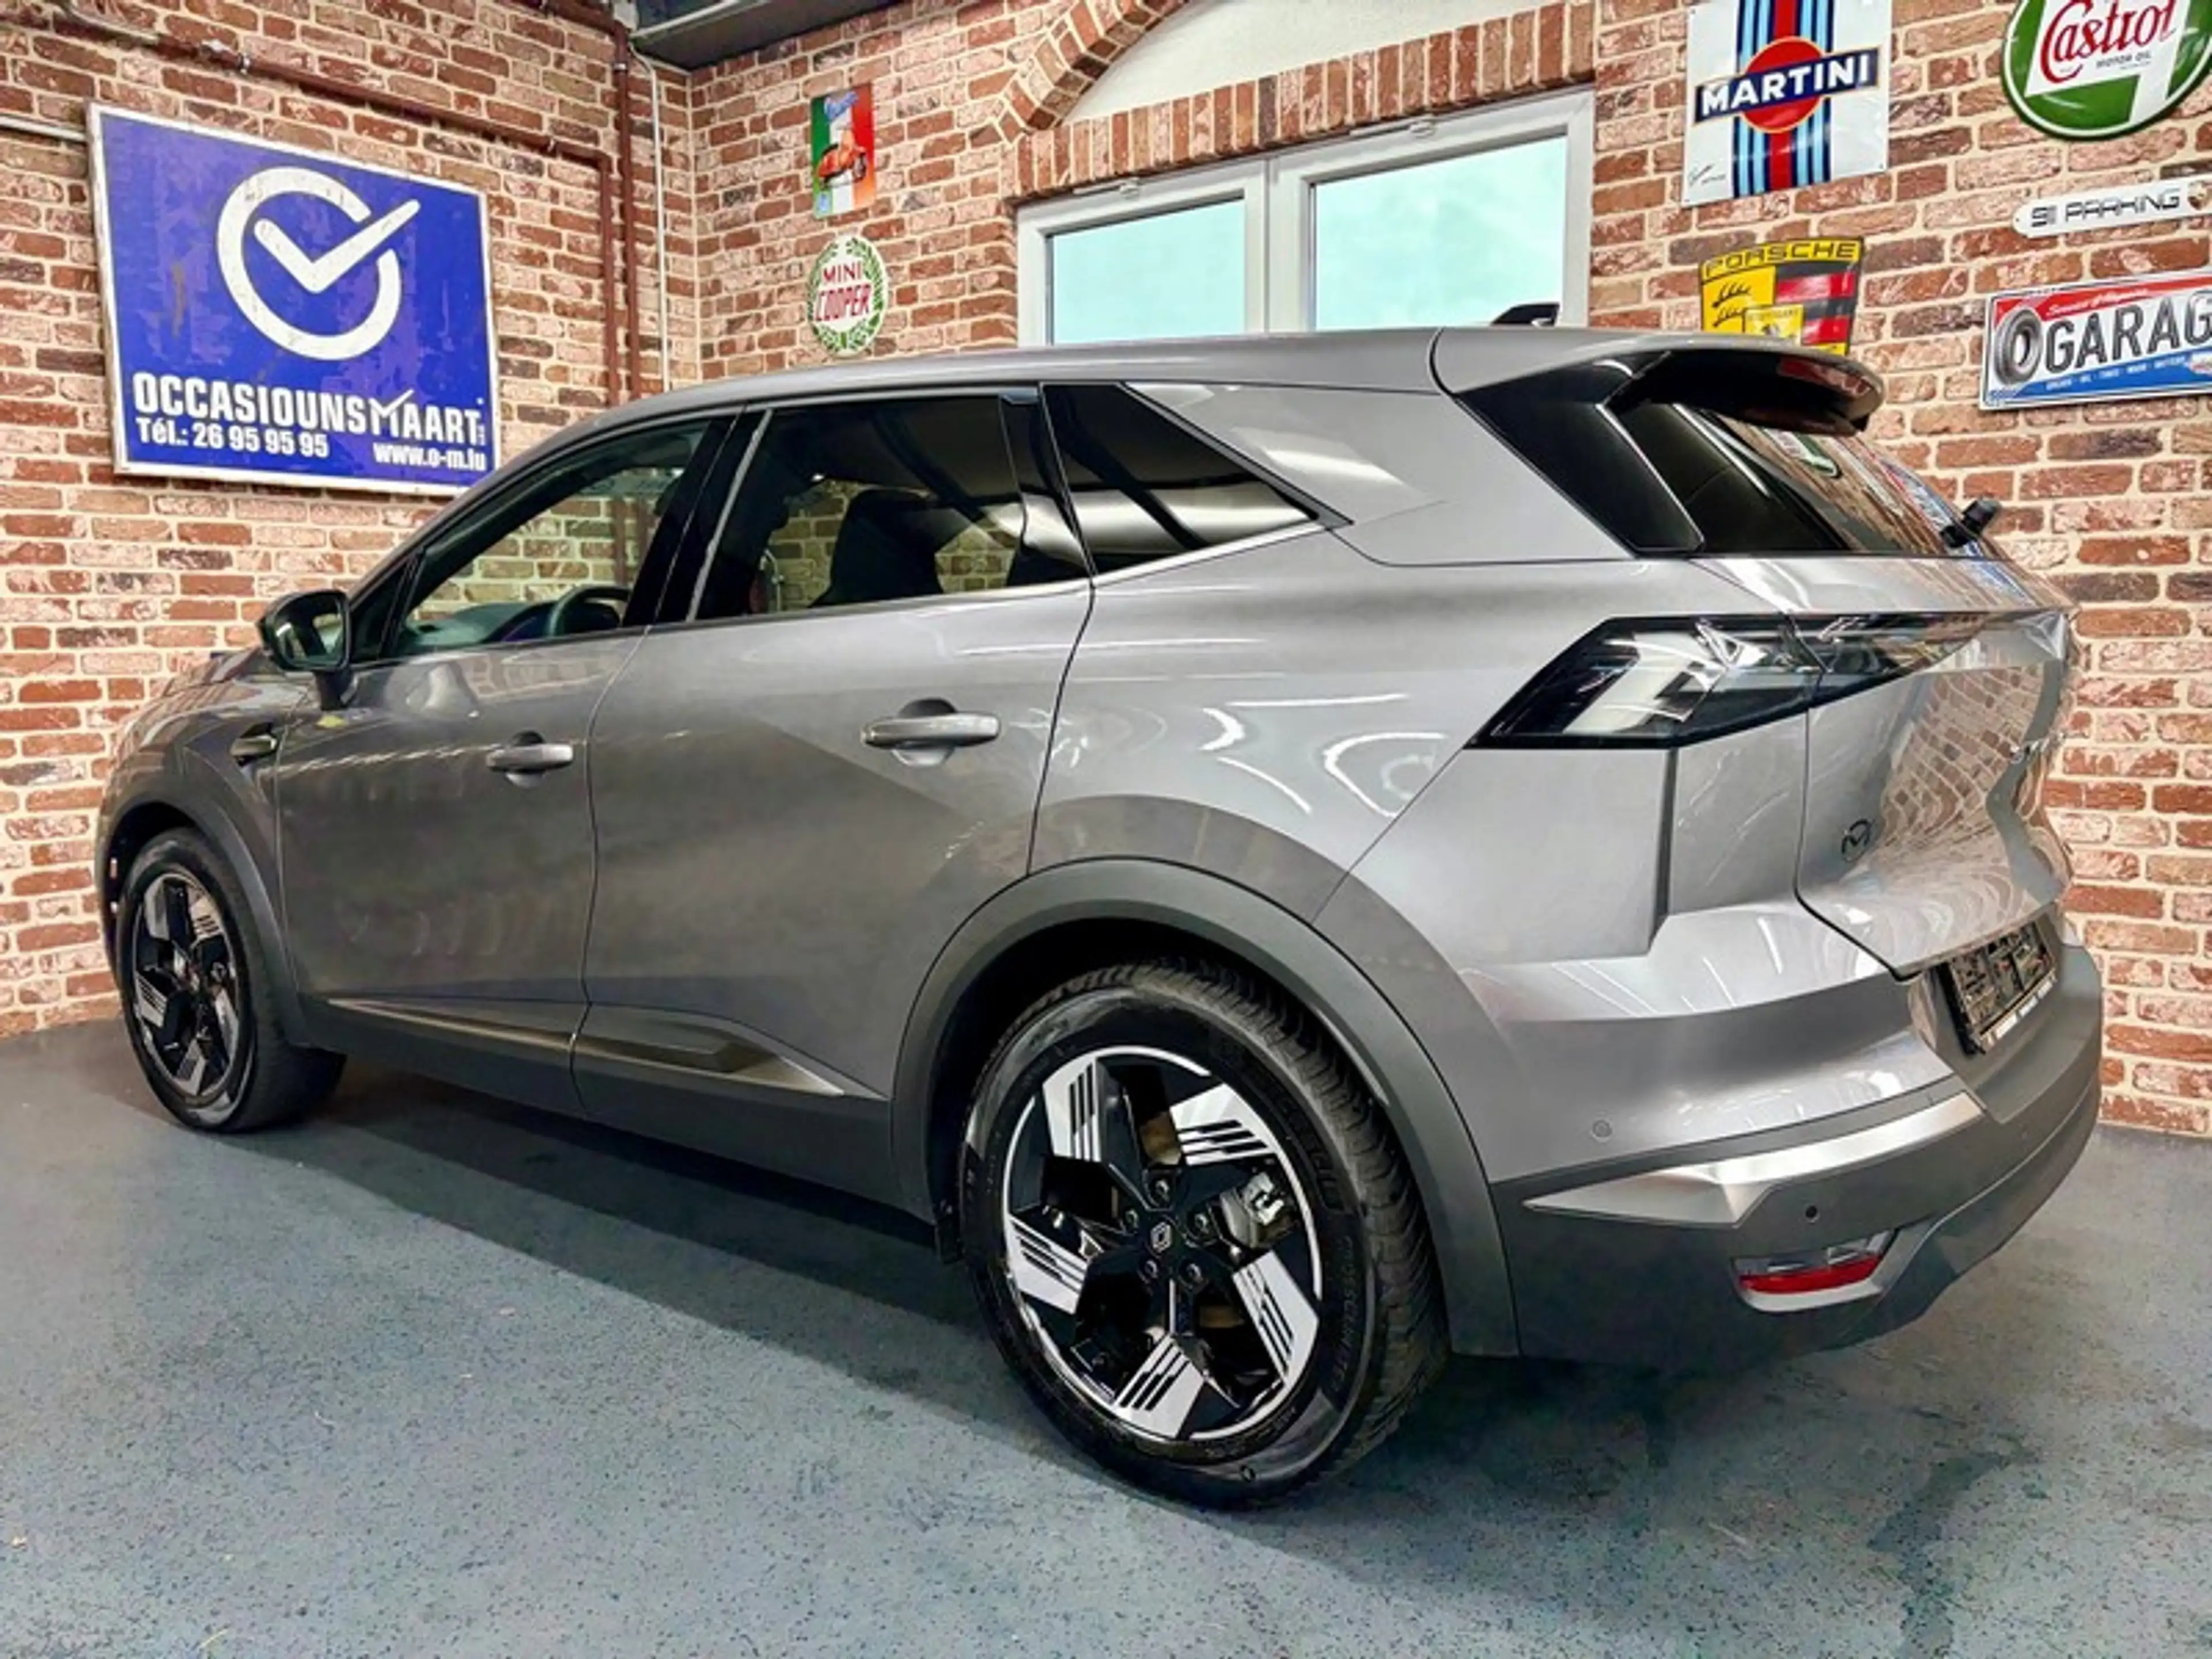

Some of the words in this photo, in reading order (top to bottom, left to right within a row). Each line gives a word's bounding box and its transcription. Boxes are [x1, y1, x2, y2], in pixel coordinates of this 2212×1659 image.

[2040, 0, 2177, 84] Castrol
[1701, 54, 1869, 116] MARTINI
[2066, 188, 2181, 222] PARKING
[823, 263, 862, 285] MINI
[1705, 243, 1856, 278] PORSCHE
[815, 284, 872, 322] COOPER
[132, 372, 482, 446] OCCASIOUNSMAART
[136, 417, 188, 446] Tél.:
[193, 425, 223, 449] 26
[229, 428, 257, 451] 95
[264, 431, 294, 454] 95
[300, 433, 329, 458] 95
